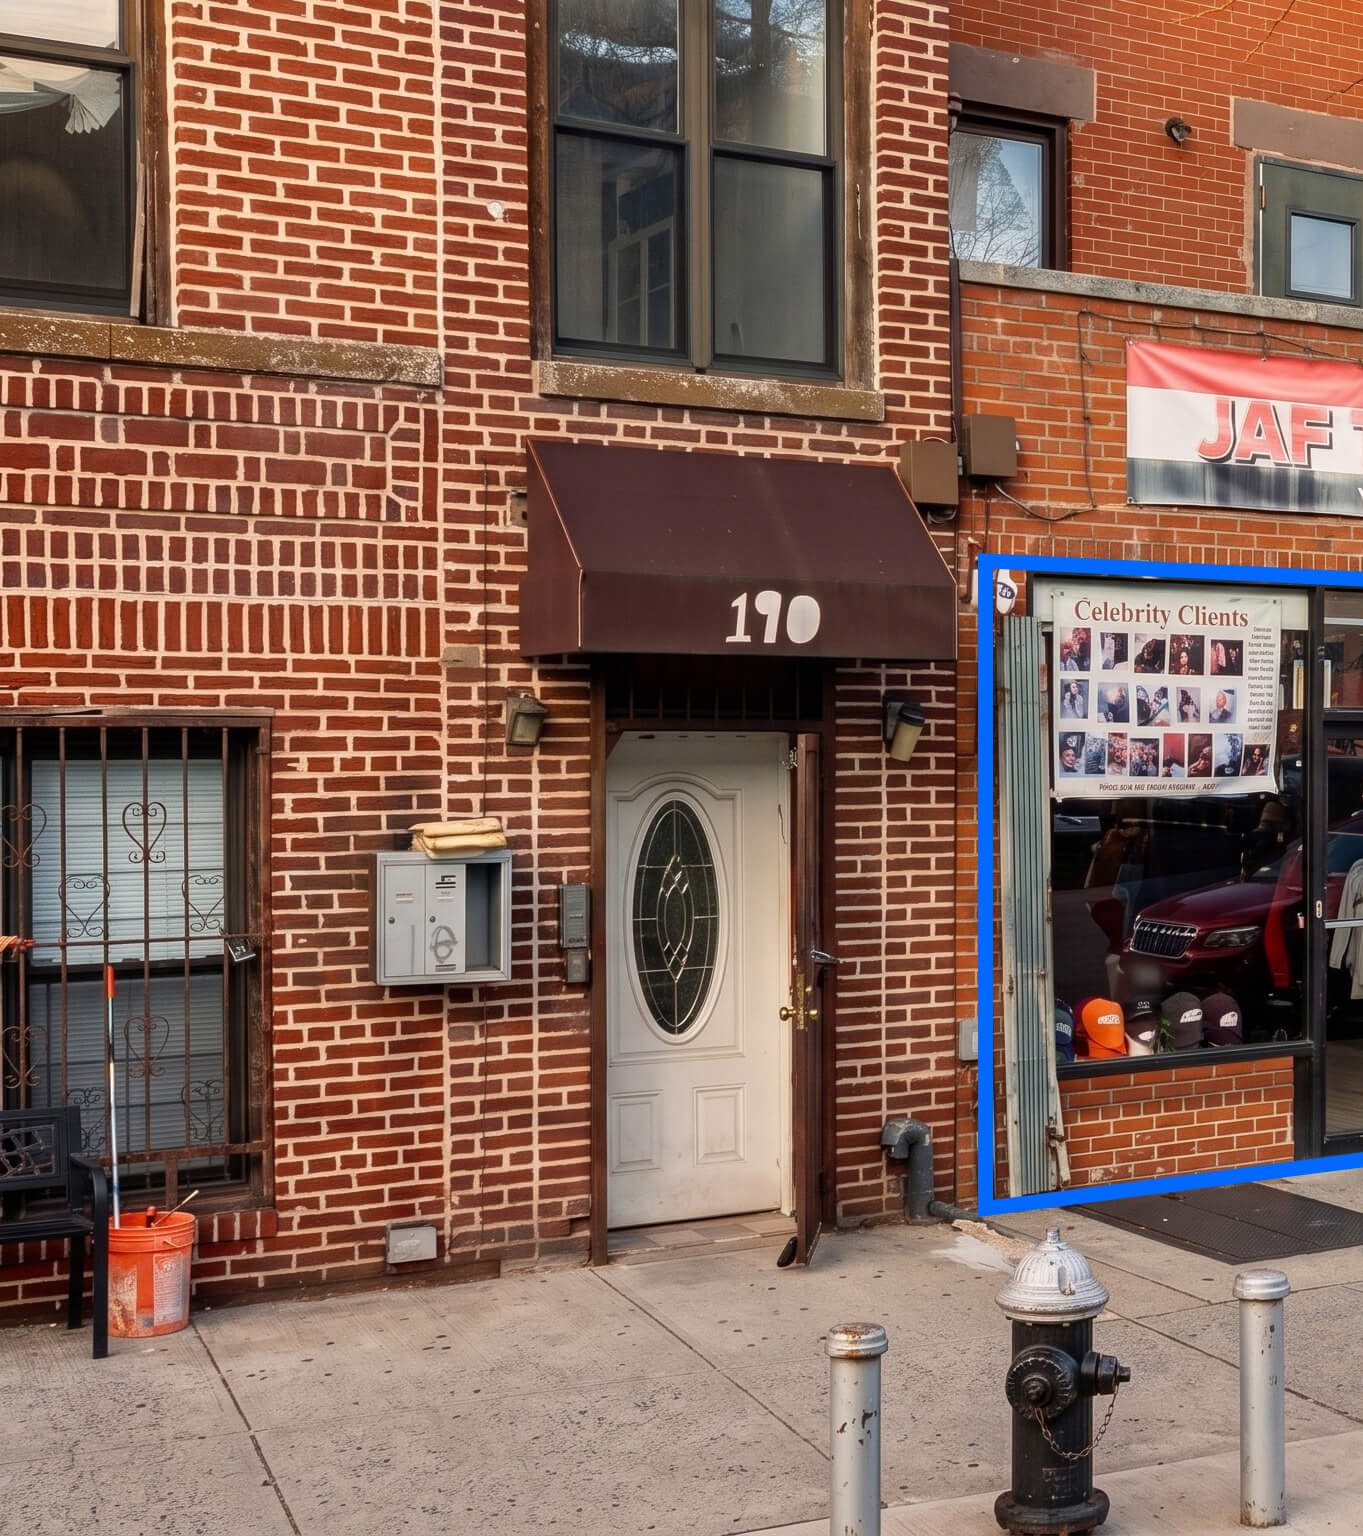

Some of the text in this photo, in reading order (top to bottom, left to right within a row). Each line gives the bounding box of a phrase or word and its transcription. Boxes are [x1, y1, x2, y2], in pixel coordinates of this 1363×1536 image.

[1198, 399, 1333, 467] JAF
[725, 590, 821, 644] 190
[1074, 599, 1249, 630] Celebrity Clients
